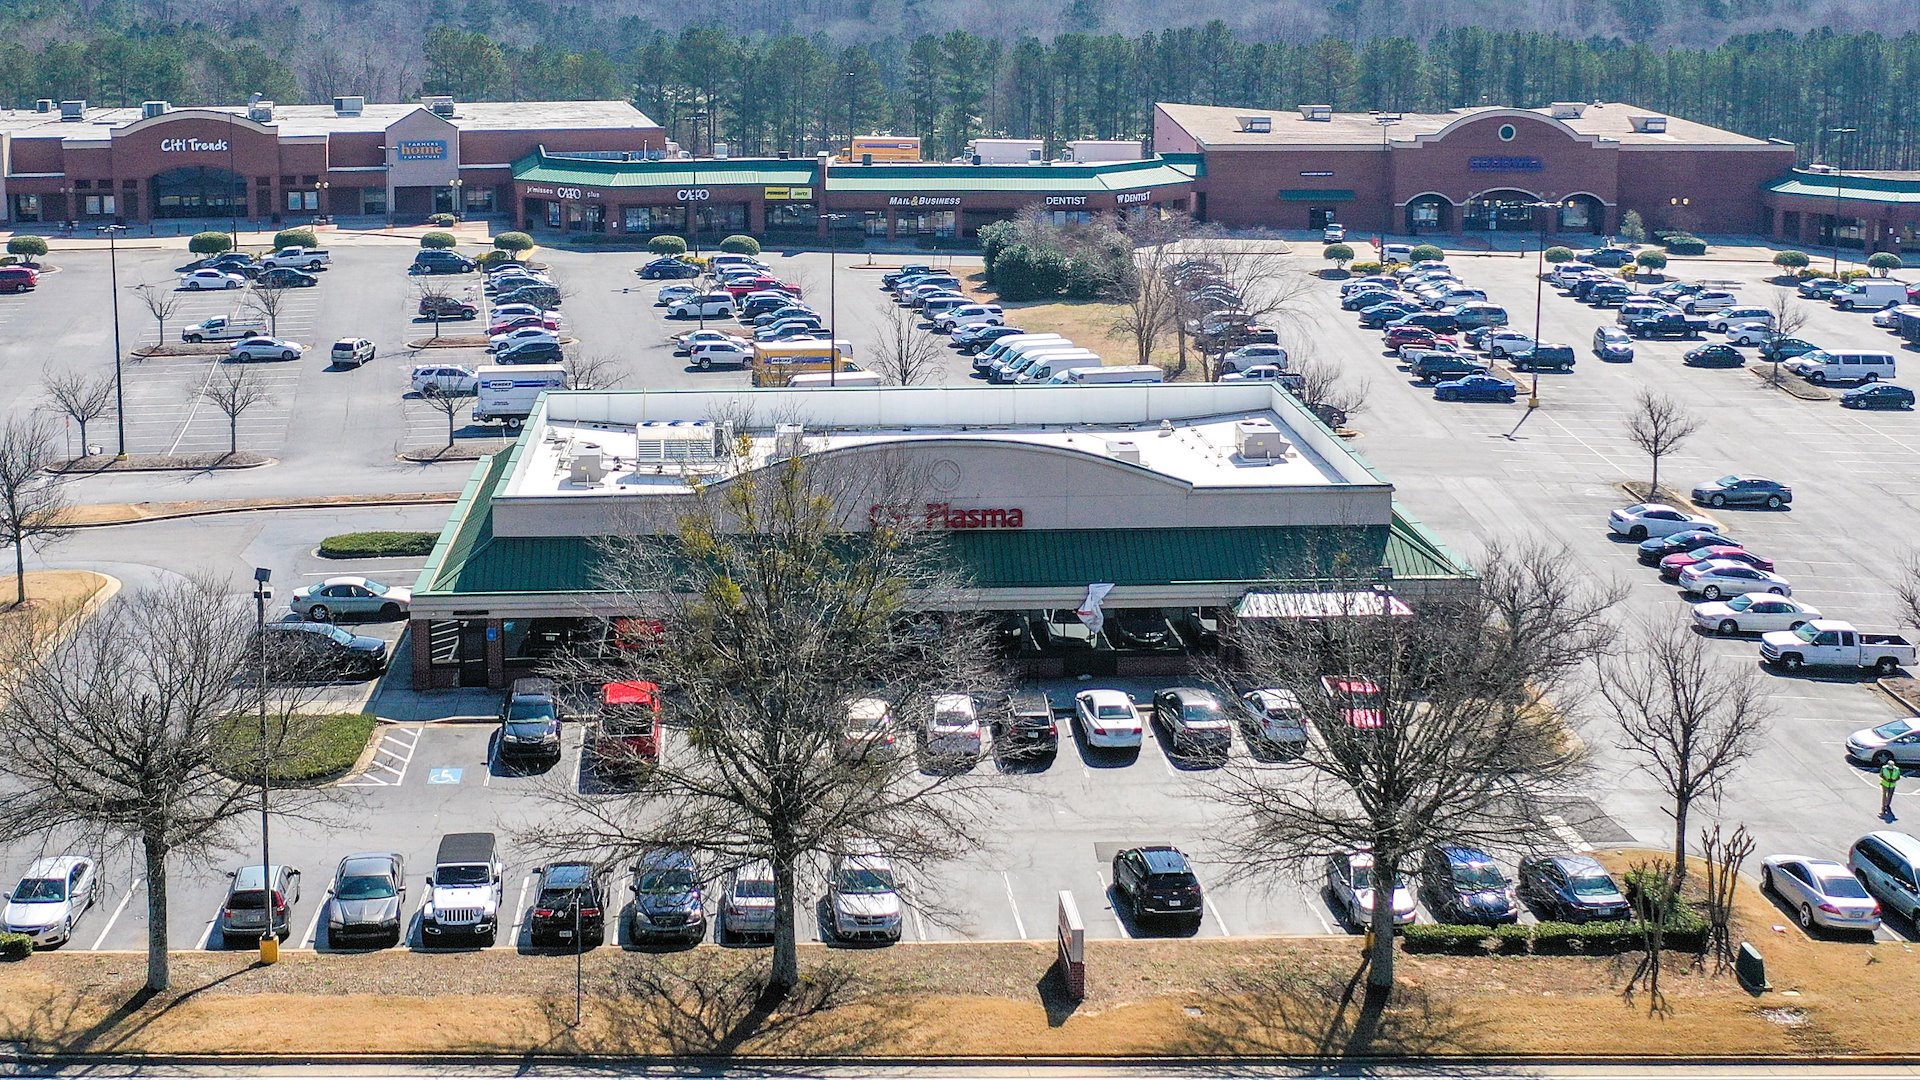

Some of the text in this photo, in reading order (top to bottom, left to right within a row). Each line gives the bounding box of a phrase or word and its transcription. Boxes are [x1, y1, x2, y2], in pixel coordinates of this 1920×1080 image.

[160, 137, 228, 152] Citi Trends
[401, 143, 443, 155] home
[557, 187, 581, 199] CATO
[677, 189, 710, 200] CATO
[1124, 191, 1151, 203] DENTIST
[1045, 196, 1087, 205] DENTIST
[926, 502, 1024, 529] Plasma
